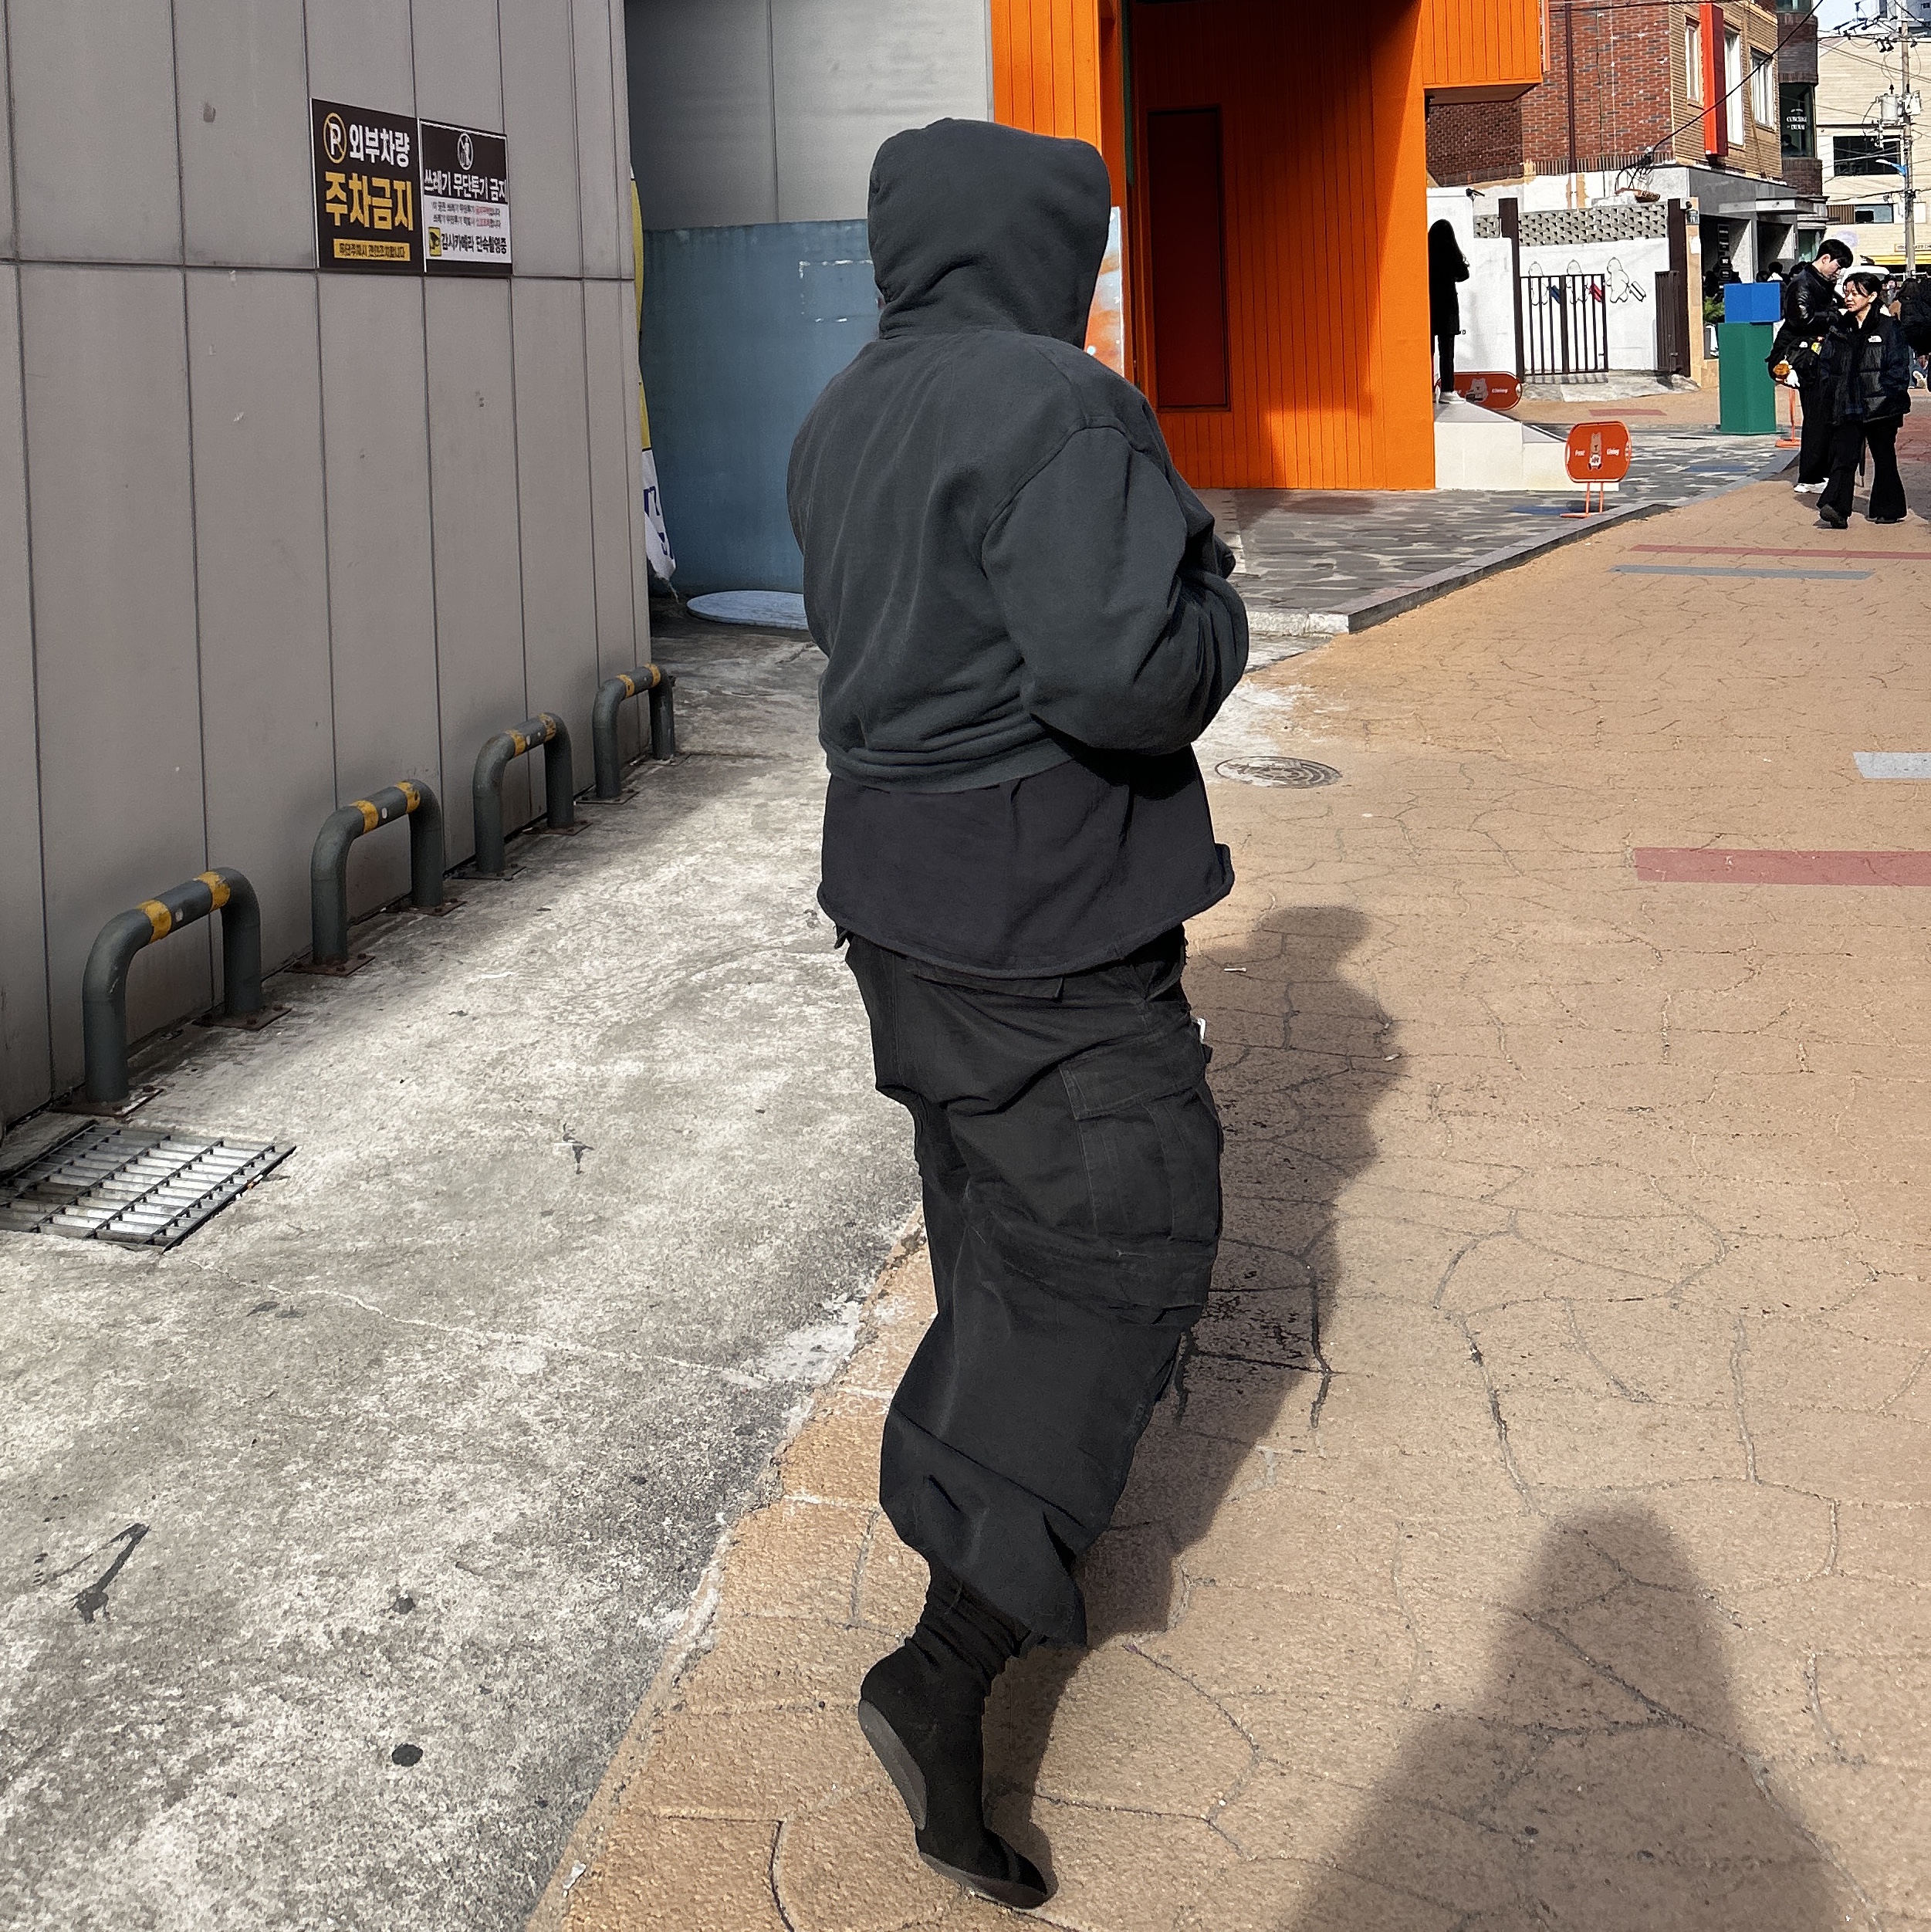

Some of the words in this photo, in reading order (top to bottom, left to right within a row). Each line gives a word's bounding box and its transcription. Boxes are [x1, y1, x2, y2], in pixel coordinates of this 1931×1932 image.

[349, 124, 411, 168] 외부차량
[325, 171, 414, 232] 주차금지
[424, 169, 451, 196] 쓰레기
[453, 173, 489, 201] 무단투기
[489, 178, 508, 202] 금지
[441, 233, 475, 252] 감시카메라
